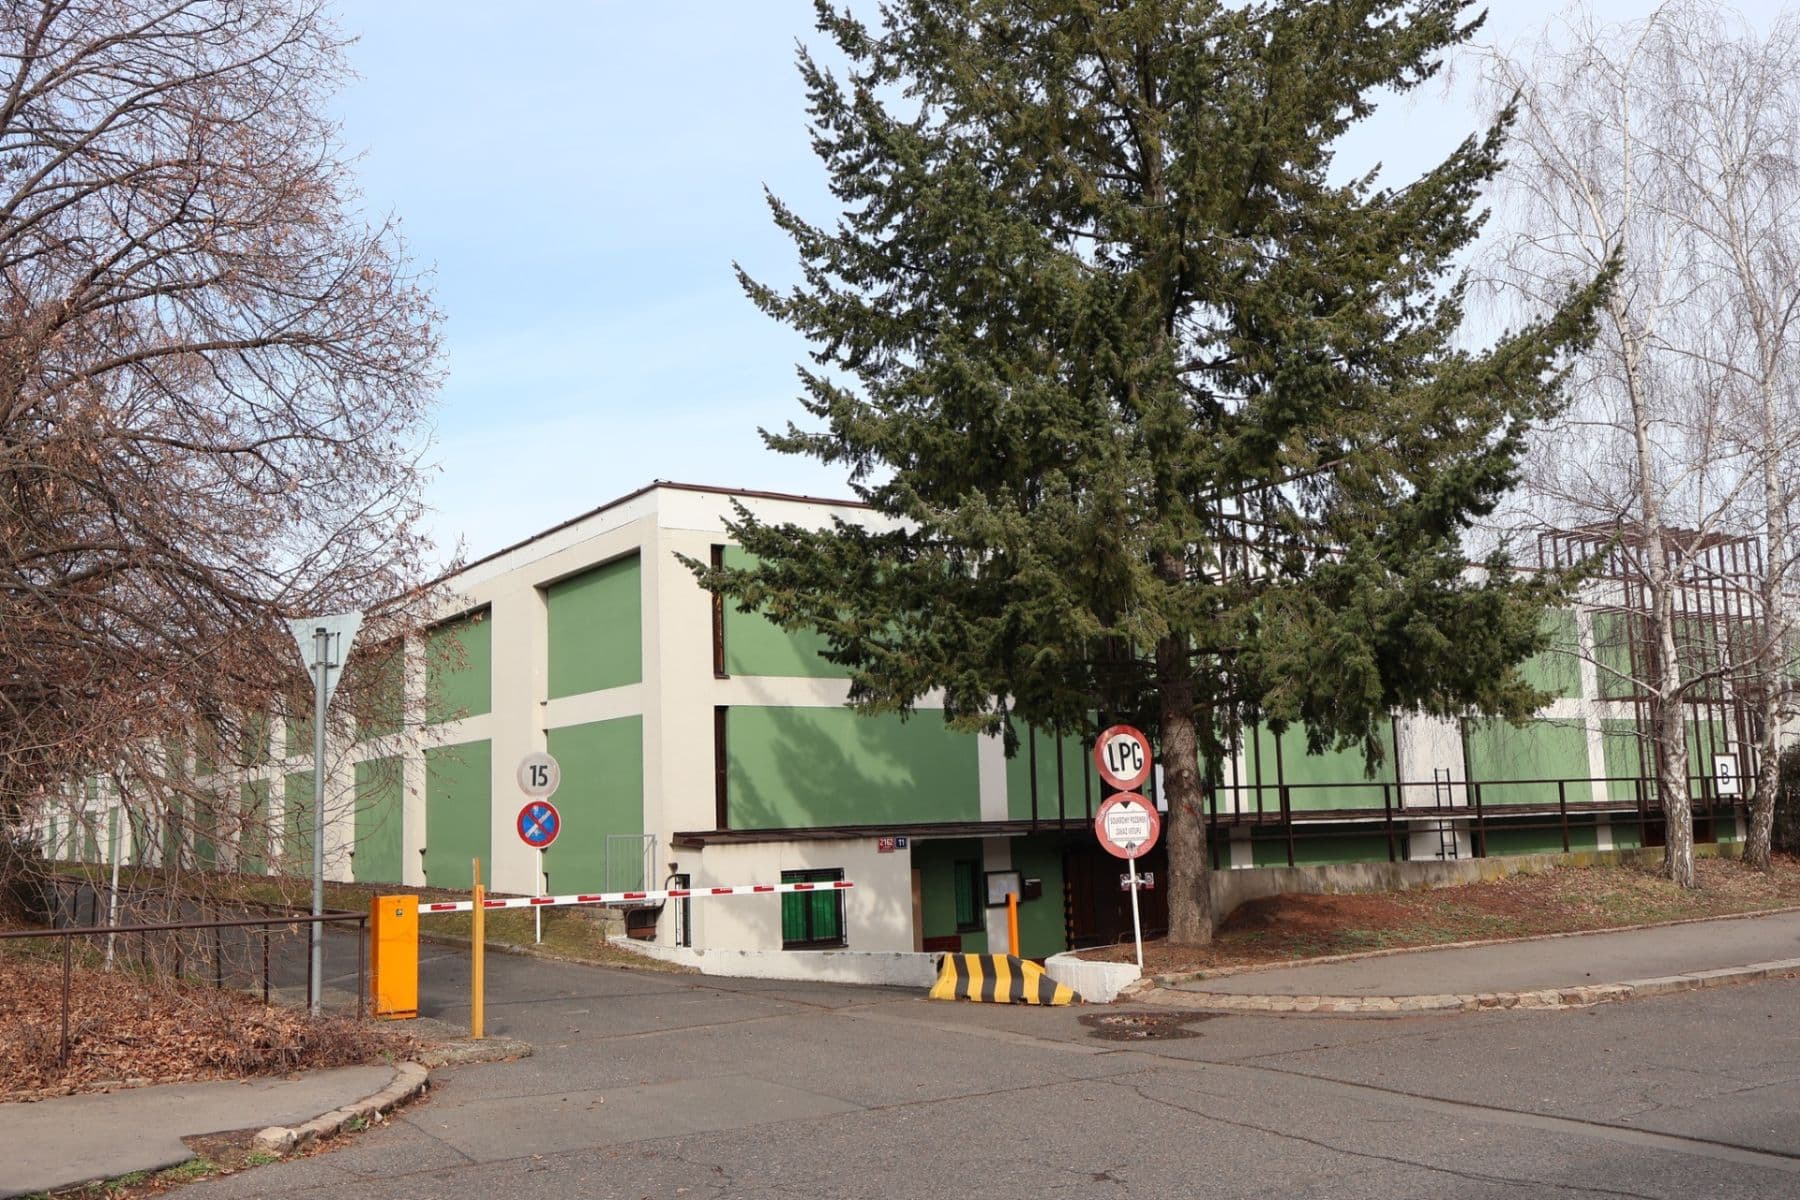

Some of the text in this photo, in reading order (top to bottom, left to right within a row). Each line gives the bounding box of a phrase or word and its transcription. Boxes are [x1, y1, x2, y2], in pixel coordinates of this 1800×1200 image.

[1108, 742, 1143, 772] LPG
[529, 765, 548, 787] 15
[1720, 763, 1730, 785] B
[898, 838, 905, 847] 11
